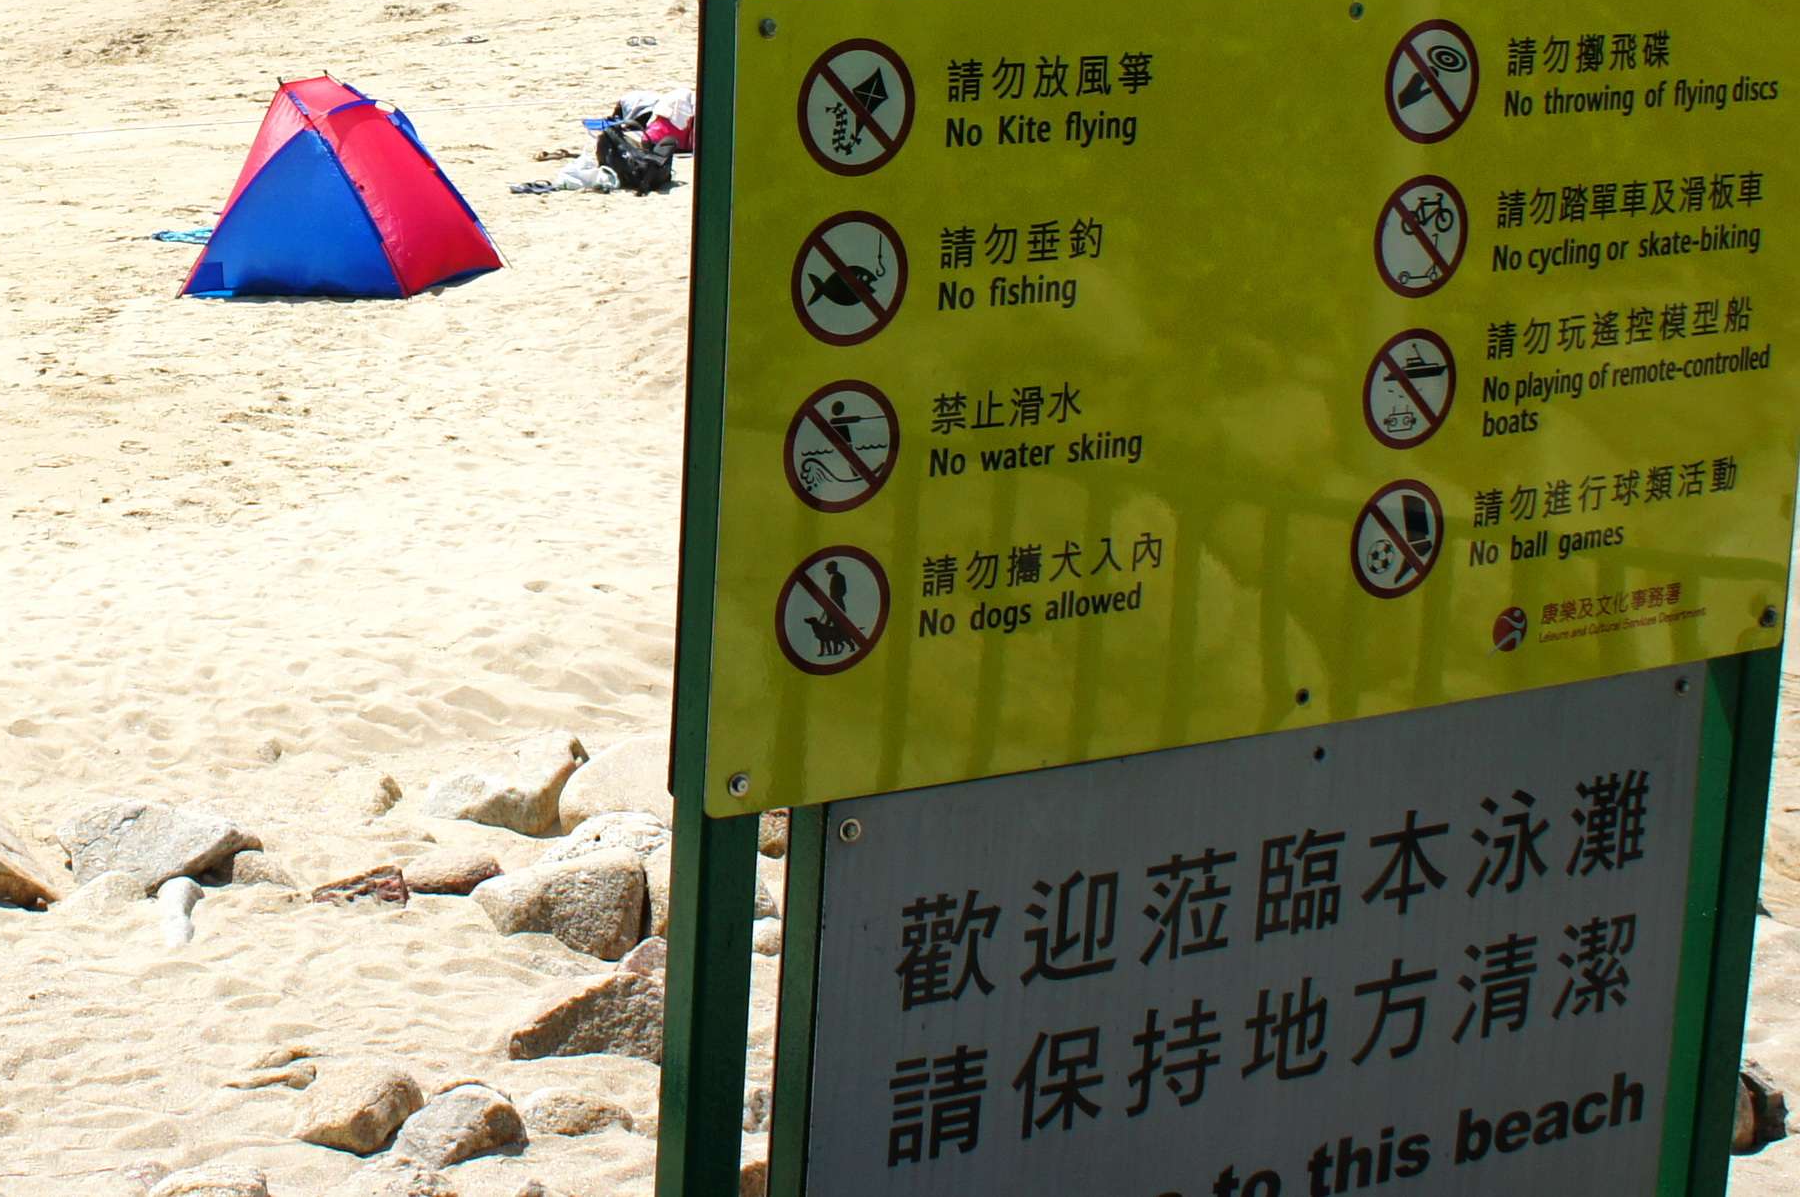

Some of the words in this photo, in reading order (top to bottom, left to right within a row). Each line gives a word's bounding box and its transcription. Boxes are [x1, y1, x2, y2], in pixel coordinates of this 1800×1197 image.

[948, 52, 1152, 102] 請勿放風箏
[1508, 30, 1670, 76] 請勿擲飛碟
[1505, 91, 1532, 116] No
[1545, 85, 1634, 116] throwing
[1645, 82, 1667, 107] of
[1675, 79, 1727, 112] flying
[1733, 76, 1777, 102] discs
[946, 118, 982, 147] No
[999, 115, 1050, 144] Kite
[1066, 111, 1136, 148] flying
[1497, 172, 1763, 228] 請勿踏單車及滑板車
[941, 218, 1102, 269] 請勿垂釣
[1493, 245, 1521, 271] No
[1529, 239, 1600, 274] cycling
[1607, 241, 1629, 260] or
[1639, 224, 1760, 257] skate-biking
[939, 282, 974, 310] No
[990, 275, 1076, 308] fishing
[1487, 297, 1752, 360] 請勿玩遙控模型船
[1483, 377, 1509, 402] No
[1515, 369, 1583, 406] playing
[1589, 363, 1609, 390] of
[1611, 344, 1770, 387] remote-controlled
[931, 382, 1081, 434] 禁止滑水
[1483, 410, 1538, 437] boats
[930, 448, 965, 477] No
[981, 443, 1054, 471] water
[1068, 432, 1142, 463] skiing
[1473, 456, 1737, 528] 請勿進行球類活動
[1470, 540, 1498, 566] No
[1511, 531, 1547, 560] ball
[1558, 526, 1623, 560] games
[919, 609, 955, 637] No
[971, 602, 1031, 633] dogs
[1046, 586, 1141, 621] allowed
[892, 769, 1649, 1011] 歡迎蒞臨本泳灘
[888, 912, 1639, 1167] 請保持地方清潔
[1308, 1127, 1429, 1197] this
[1455, 1072, 1644, 1163] beach
